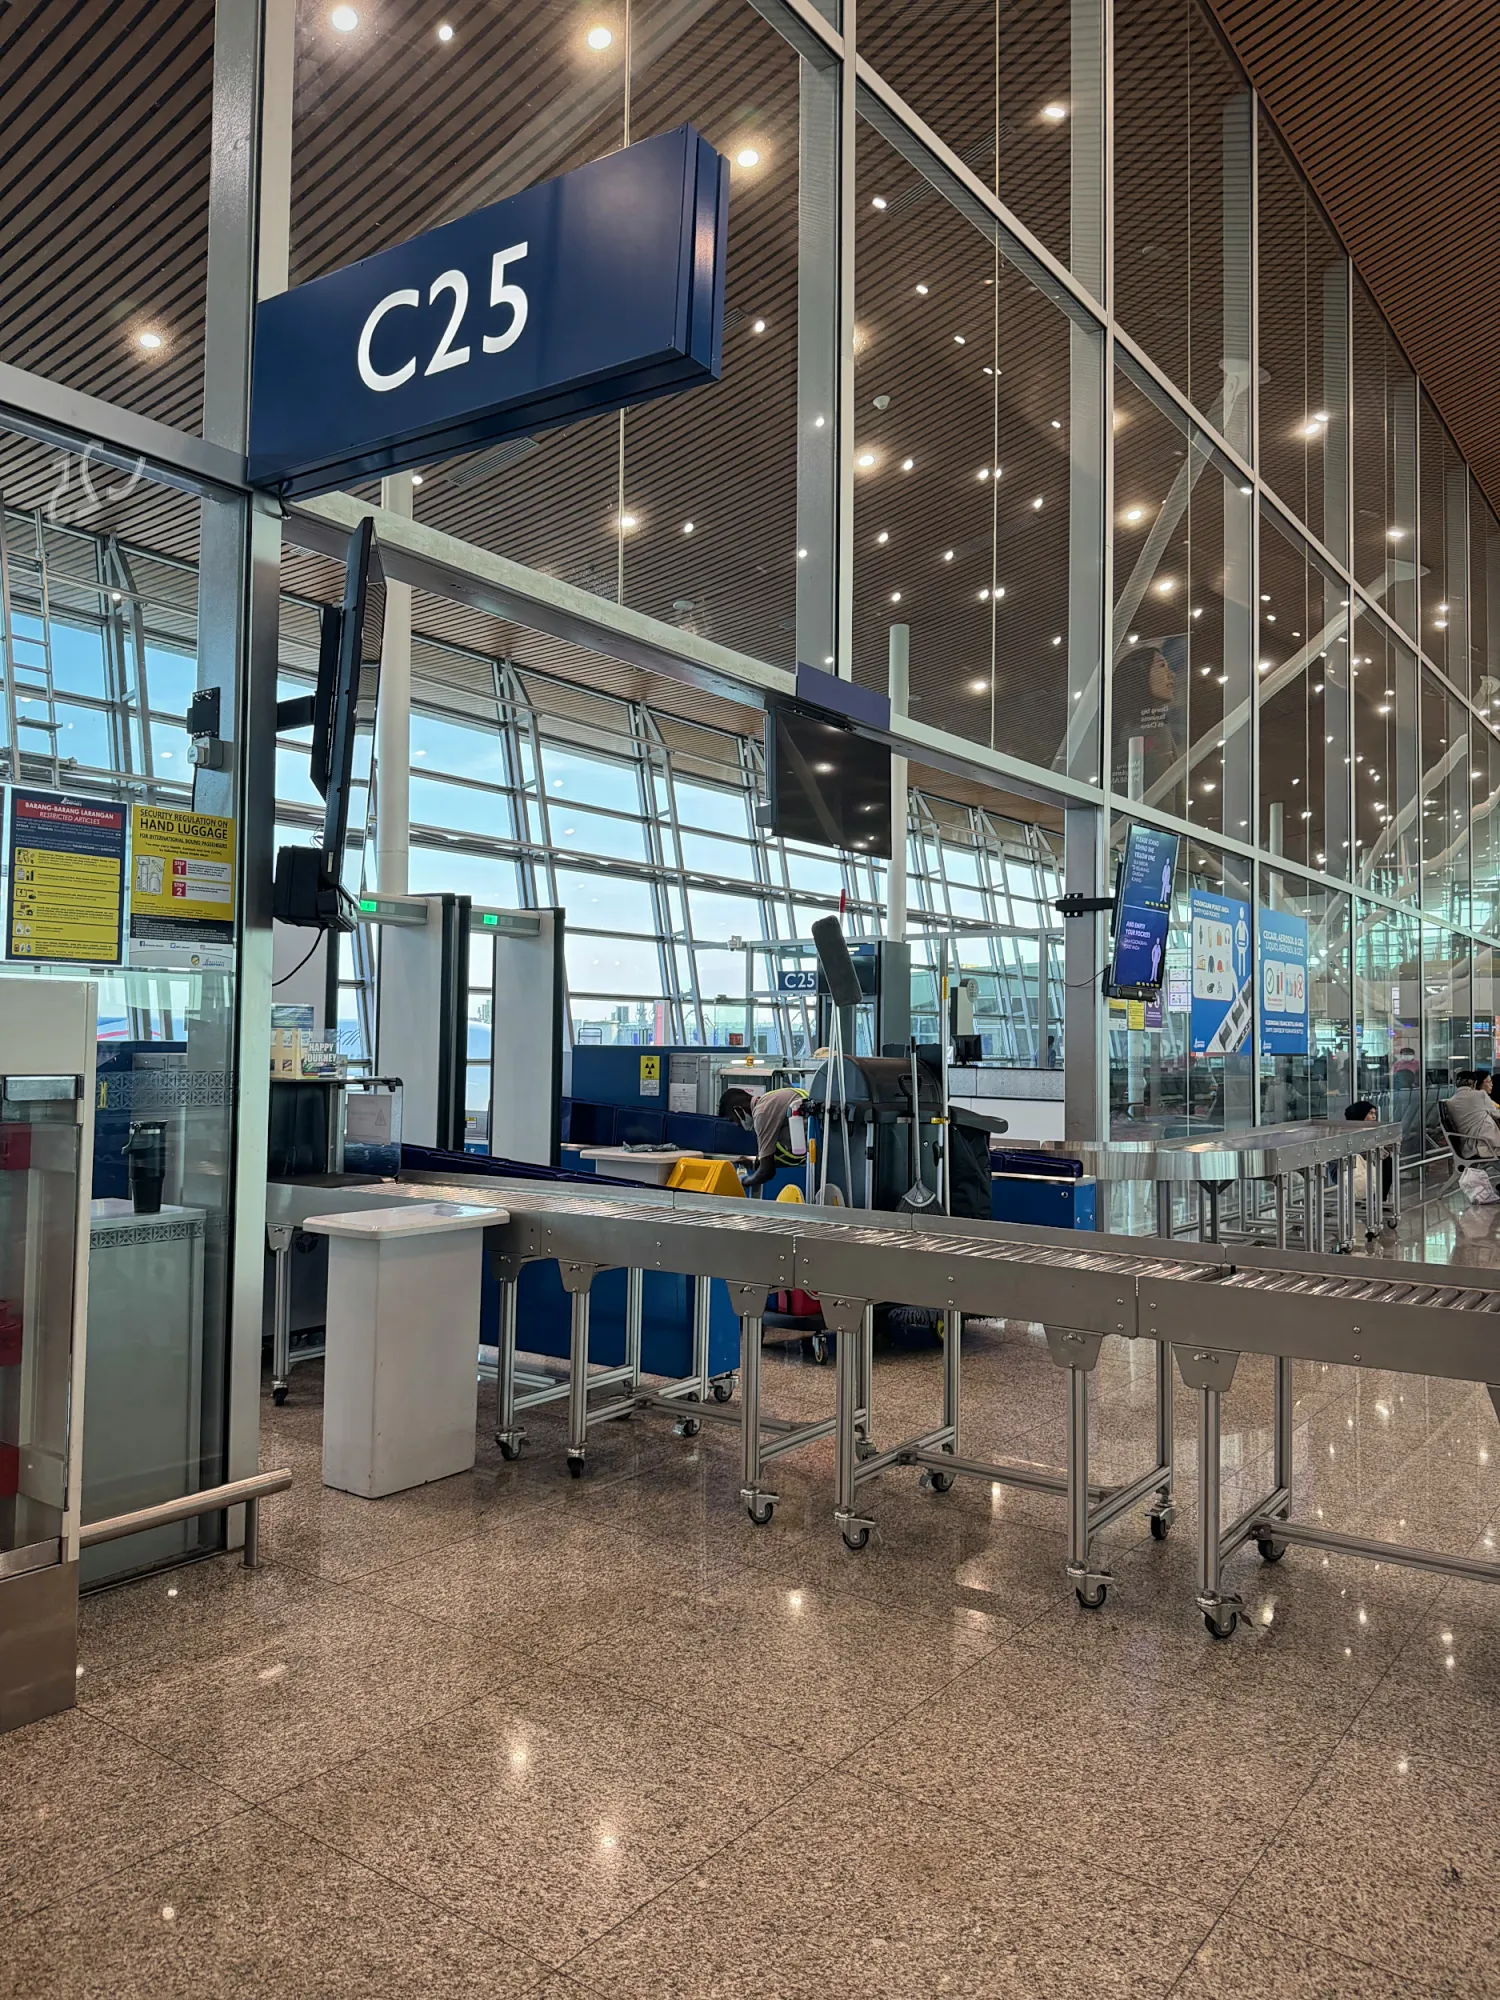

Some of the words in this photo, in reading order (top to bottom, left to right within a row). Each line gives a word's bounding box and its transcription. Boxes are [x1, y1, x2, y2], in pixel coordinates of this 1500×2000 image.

[357, 241, 529, 392] C25
[25, 802, 80, 815] BARANG-BARANG
[81, 810, 114, 820] LARANGAN
[39, 811, 73, 822] RESTRICTED
[73, 816, 100, 825] ARTICLES
[140, 808, 173, 820] SECURITY
[174, 814, 216, 826] REGULATION
[217, 820, 228, 828] ON
[140, 818, 174, 832] HAND
[177, 823, 228, 839] LUGGAGE
[149, 833, 184, 844] INTERNATIONAL
[201, 840, 228, 849] PASSENGERS
[177, 866, 182, 874] 1
[176, 888, 182, 896] 2
[784, 973, 815, 988] C25
[309, 1042, 334, 1052] HAPPY
[304, 1053, 337, 1063] JOURNEY
